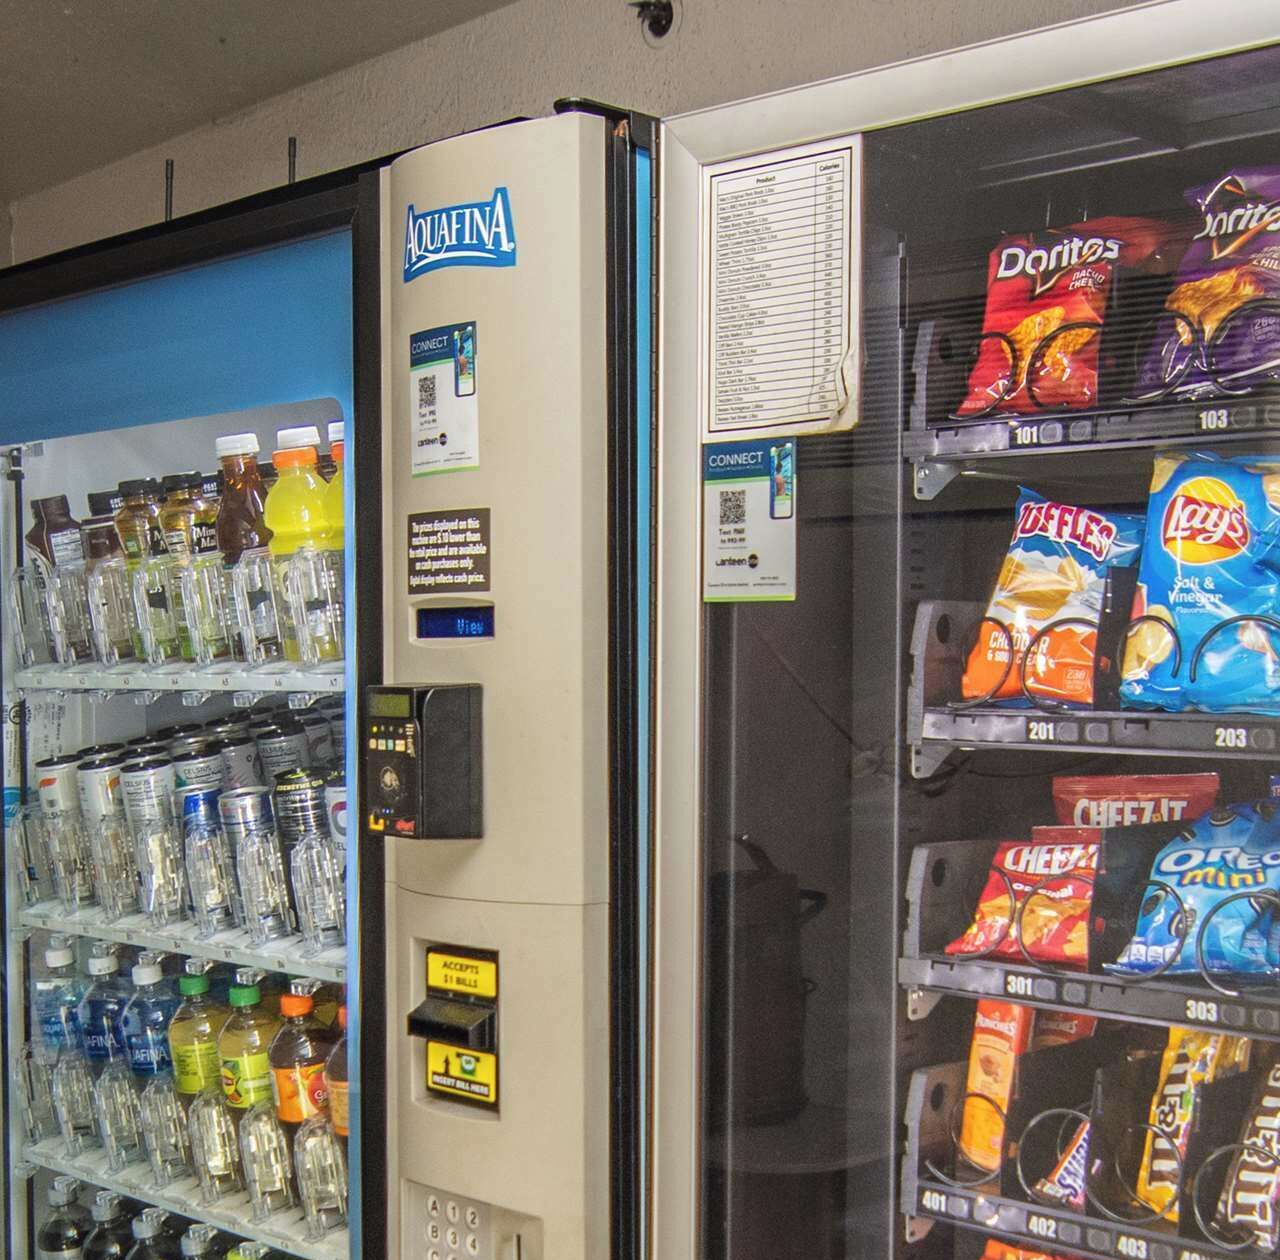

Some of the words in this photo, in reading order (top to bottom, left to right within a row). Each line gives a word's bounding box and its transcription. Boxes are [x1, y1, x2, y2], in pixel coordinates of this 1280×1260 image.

[404, 193, 514, 270] AQUAFINA
[997, 236, 1123, 280] Doritos
[411, 335, 448, 354] CONNECT
[1199, 409, 1228, 430] 103
[1015, 425, 1038, 445] 101
[709, 451, 764, 467] CONNECT
[1168, 496, 1246, 545] Lay's
[1011, 502, 1117, 561] UFFLES
[1174, 575, 1202, 590] Salt
[1203, 575, 1215, 589] &
[1168, 590, 1223, 607] Vinegar
[1028, 723, 1055, 740] 201
[1215, 727, 1246, 748] 203
[1180, 866, 1266, 890] mini
[442, 961, 479, 975] ACCEPTS
[456, 977, 478, 988] BILLS
[1007, 976, 1033, 995] 301
[1186, 1000, 1218, 1022] 303
[922, 1191, 946, 1210] 401
[1029, 1215, 1057, 1238] 402
[1118, 1236, 1147, 1259] 403
